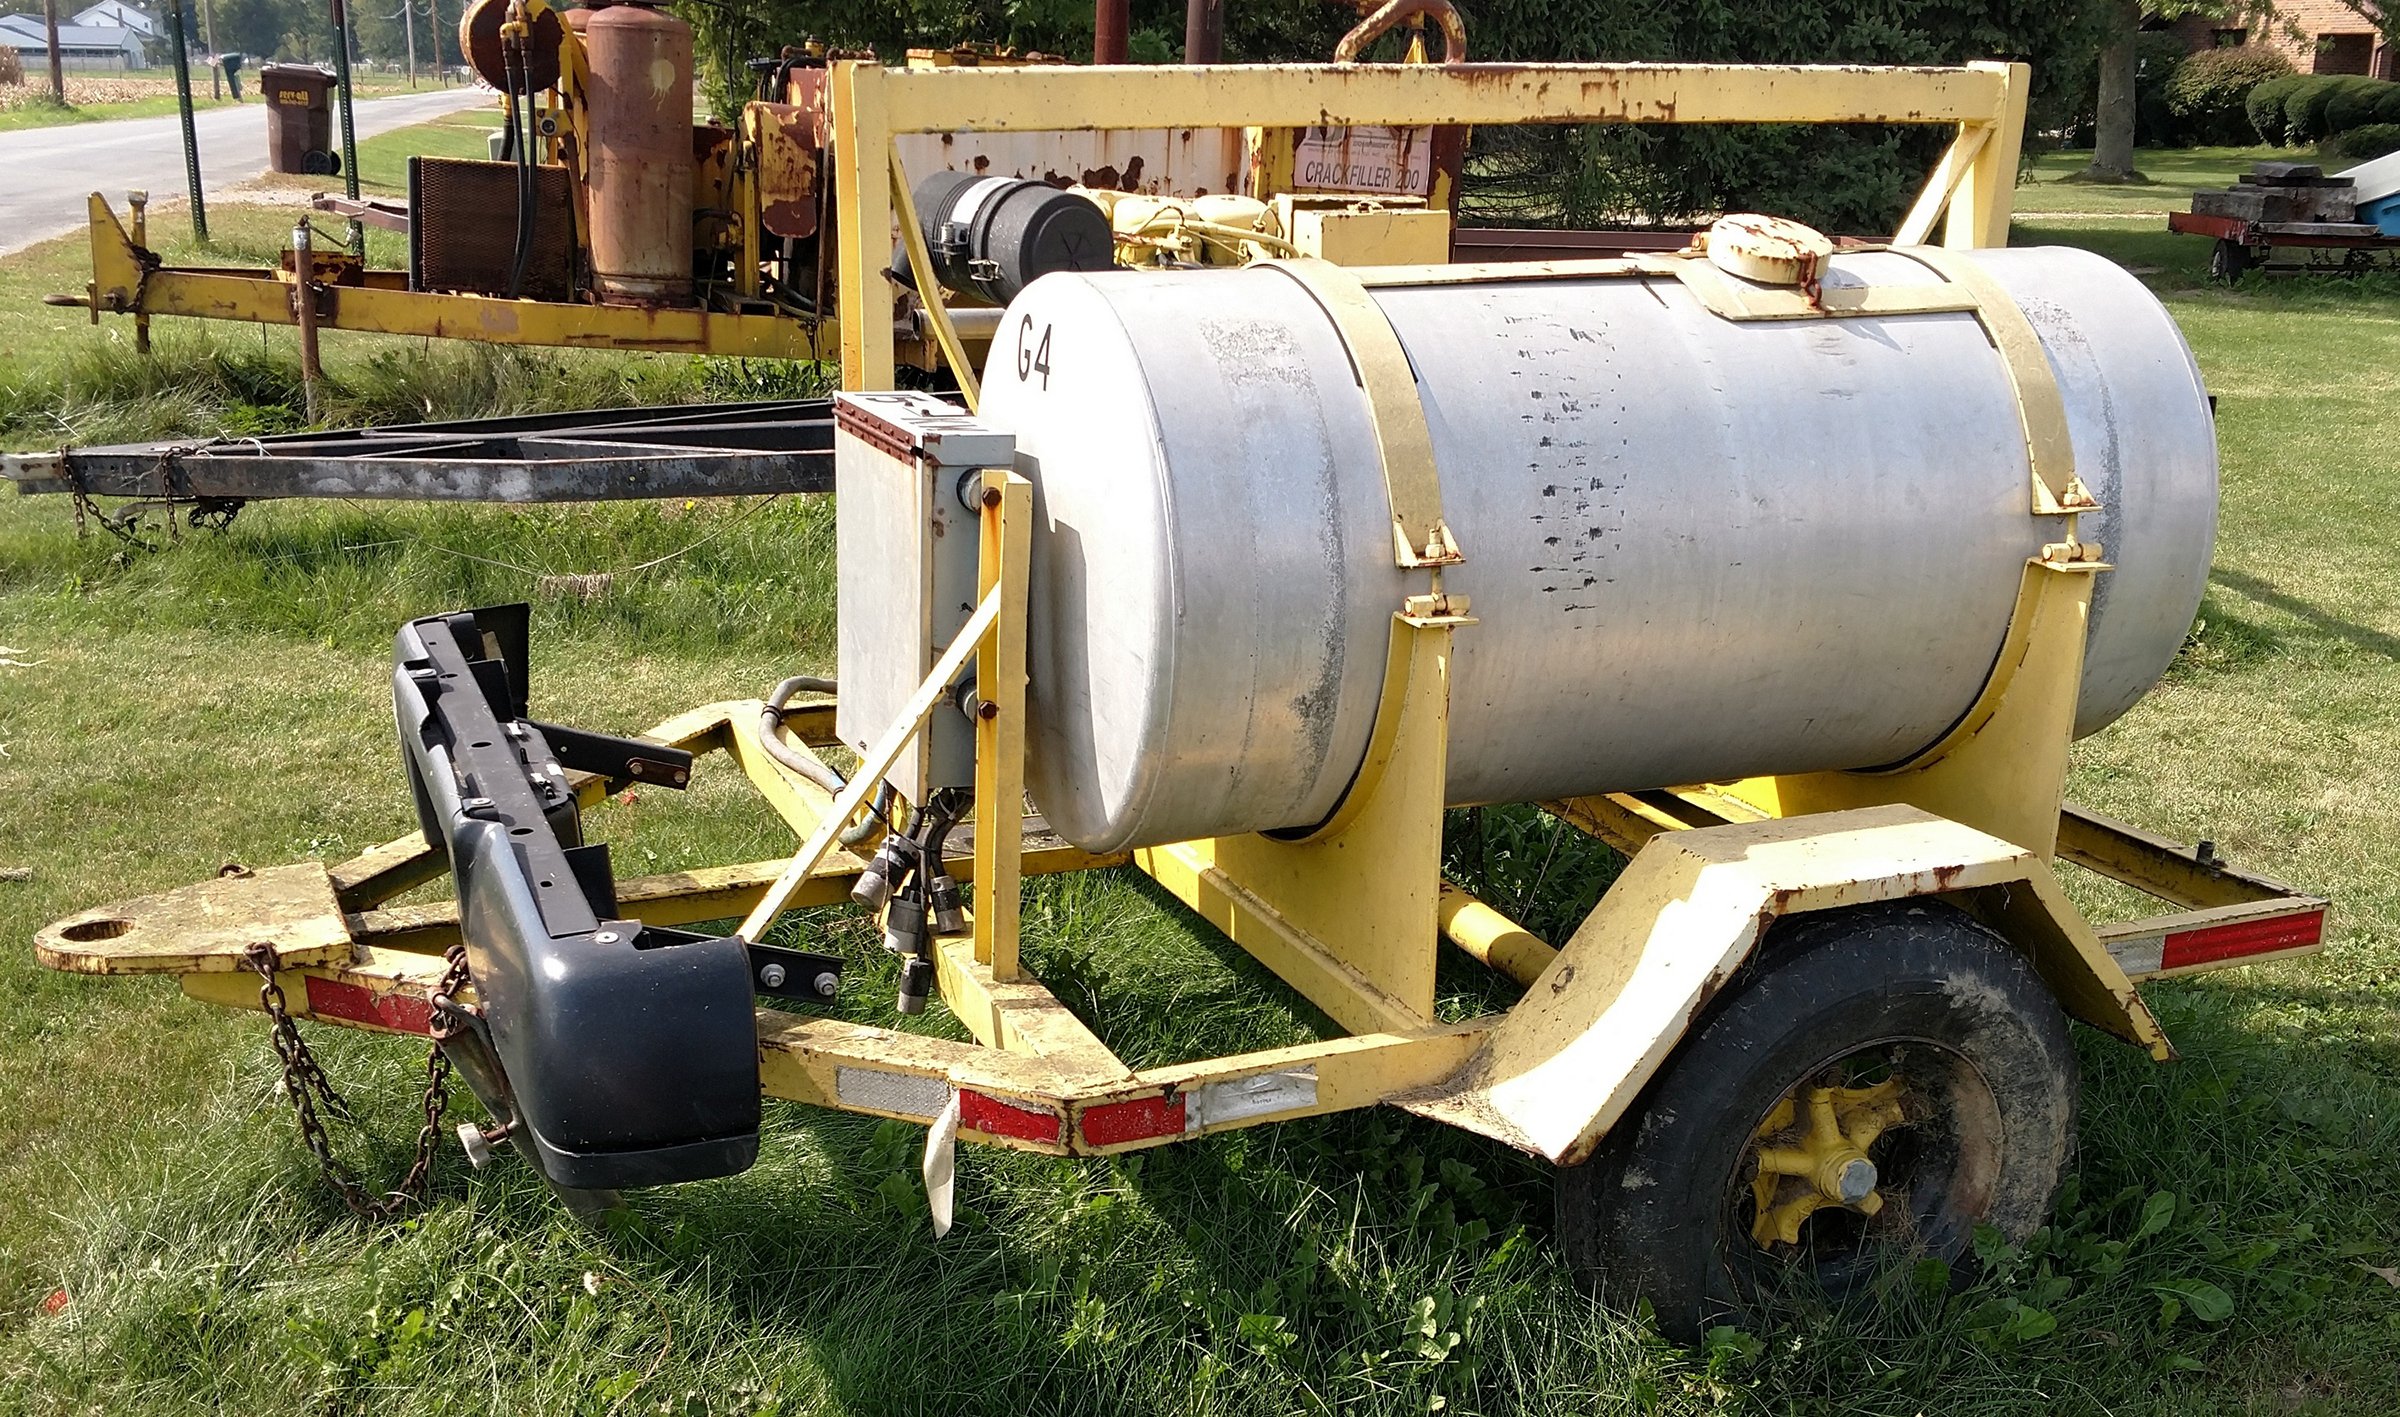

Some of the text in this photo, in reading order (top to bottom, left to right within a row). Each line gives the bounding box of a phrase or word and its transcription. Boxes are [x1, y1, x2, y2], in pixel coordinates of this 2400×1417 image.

[1305, 161, 1420, 190] CRACKFILLER 200
[1018, 313, 1051, 391] G4
